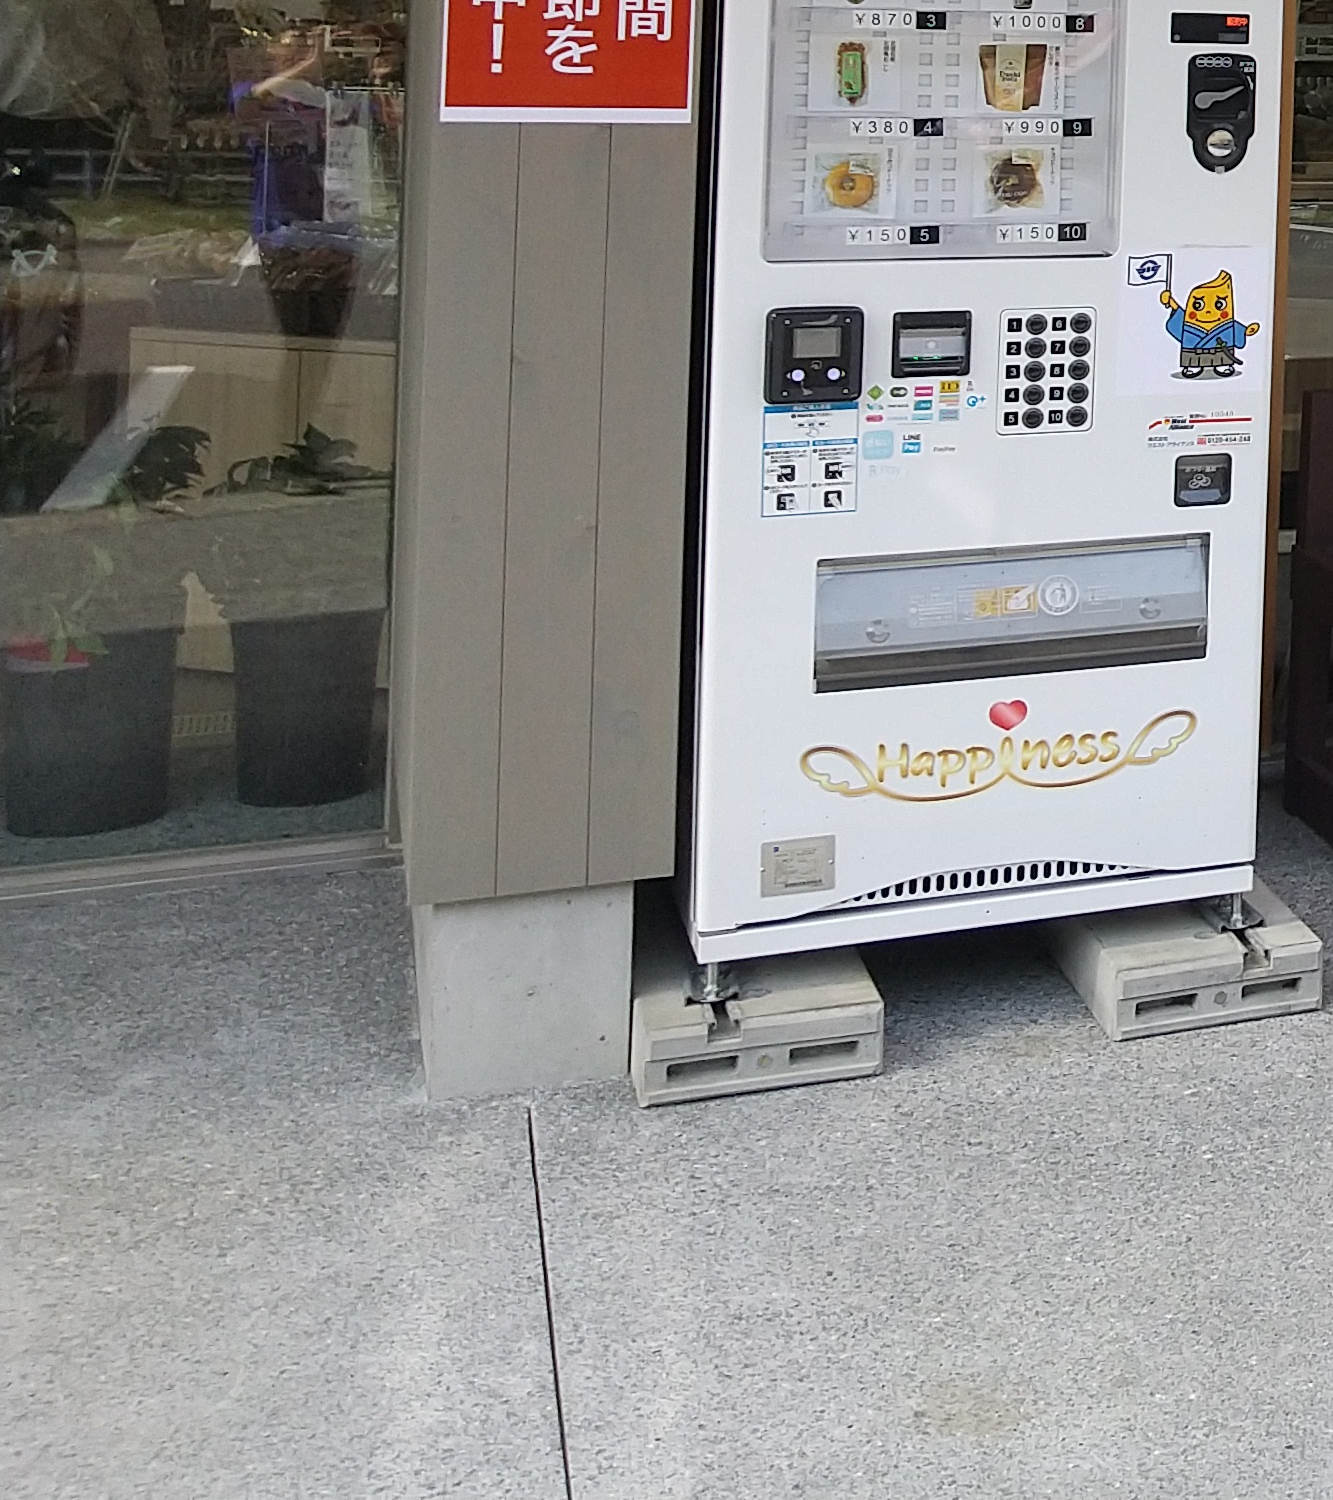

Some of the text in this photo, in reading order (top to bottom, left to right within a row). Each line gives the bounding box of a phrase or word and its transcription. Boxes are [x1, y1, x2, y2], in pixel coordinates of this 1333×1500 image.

[855, 13, 936, 27] ¥870 3
[993, 15, 1085, 30] ¥1000 8
[852, 121, 933, 134] ¥380 4
[1004, 121, 1082, 134] ¥990 9
[848, 228, 930, 242] ¥150 5
[999, 226, 1081, 240] ¥150 10
[903, 433, 921, 441] LINE
[877, 729, 1119, 788] Happiness
